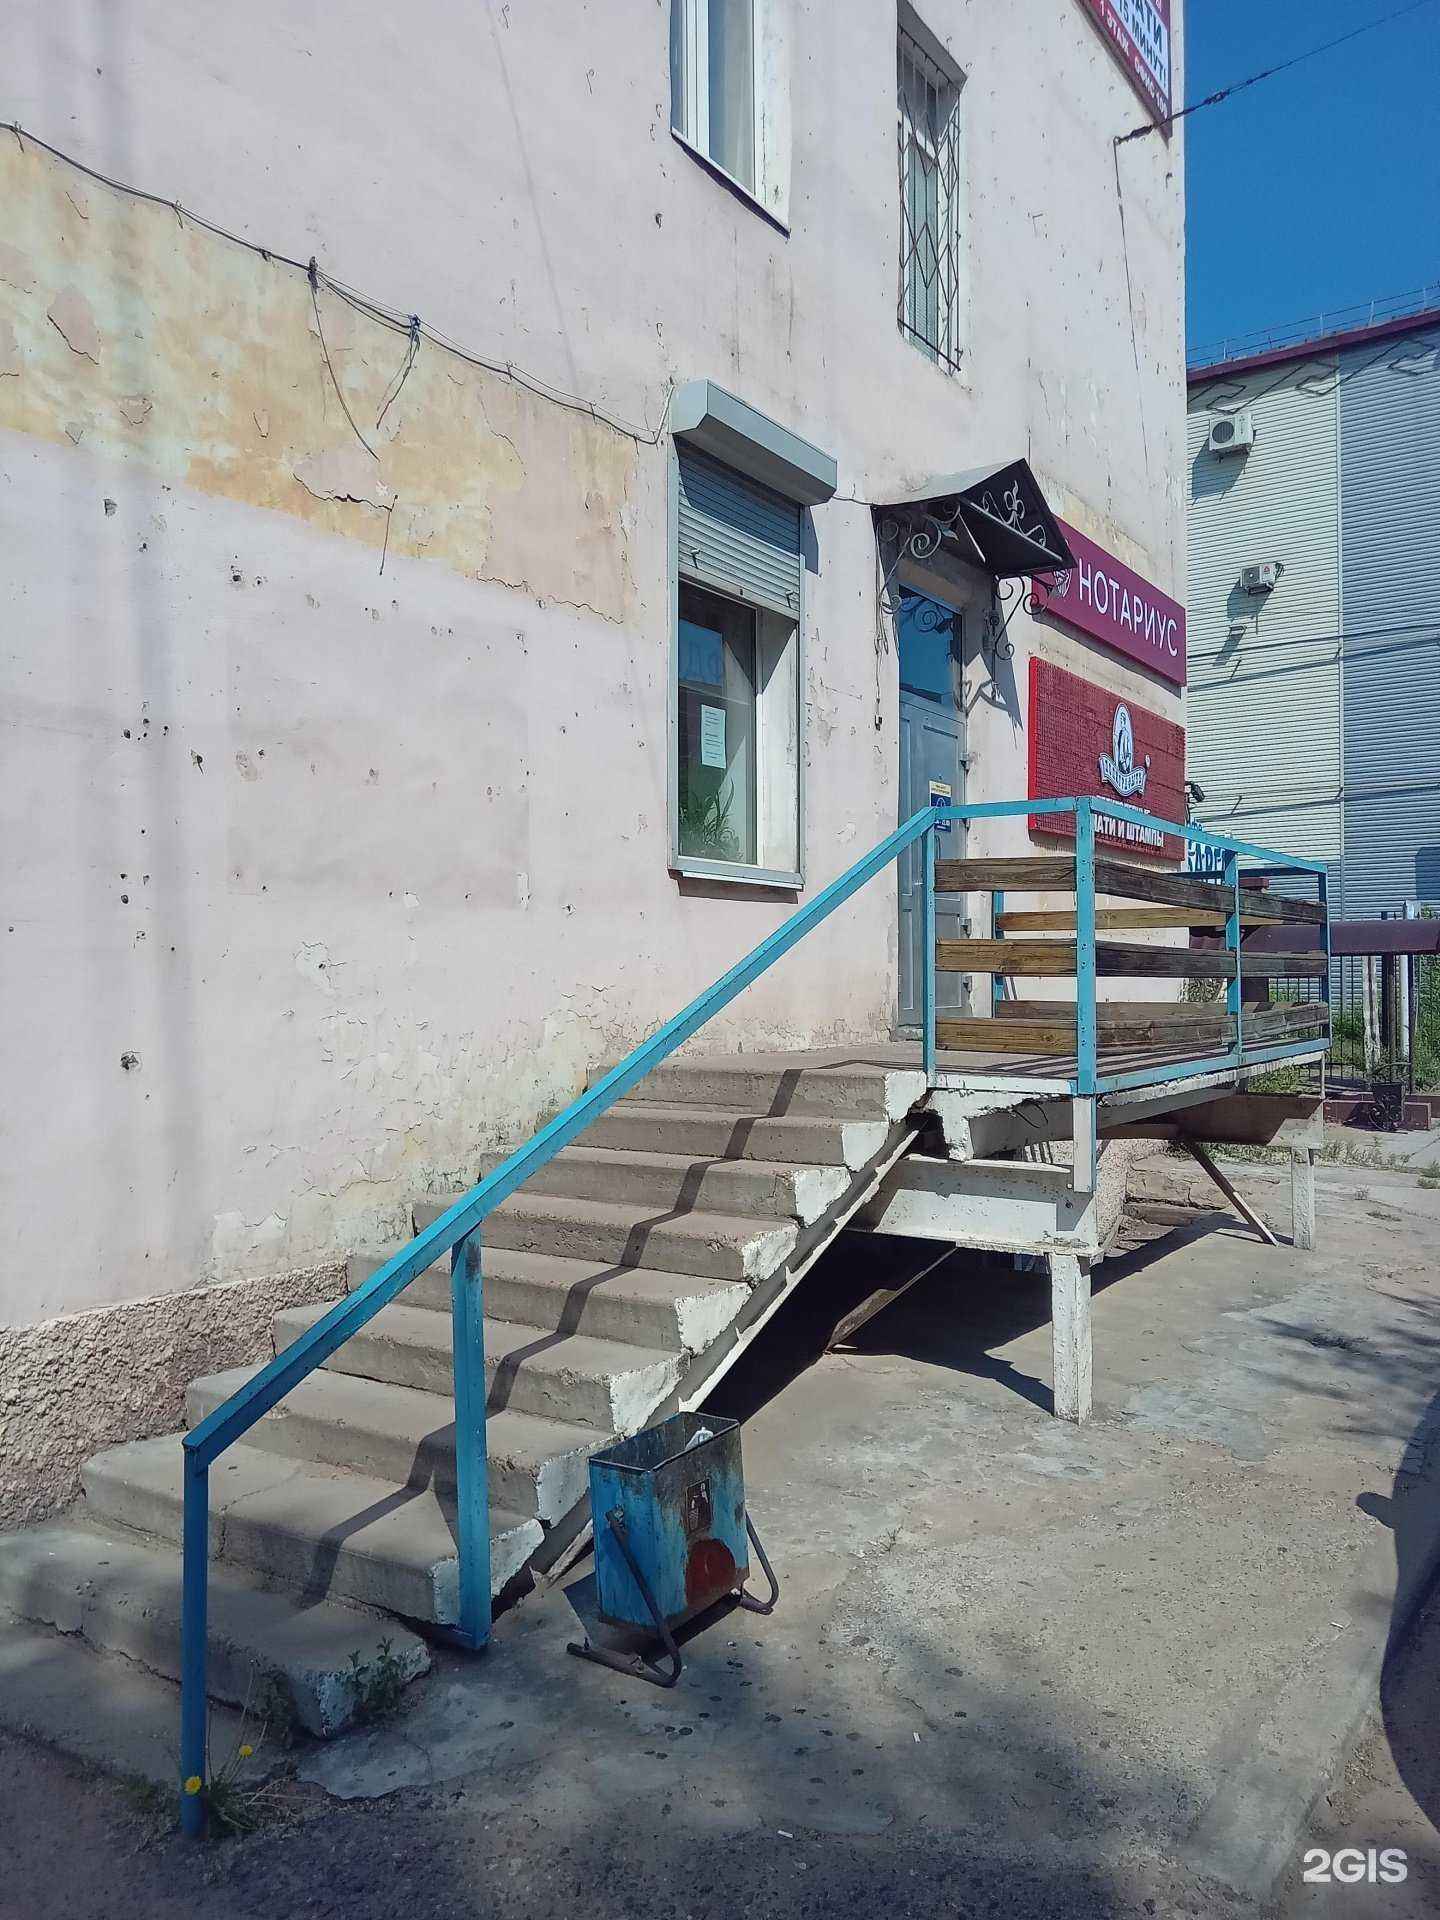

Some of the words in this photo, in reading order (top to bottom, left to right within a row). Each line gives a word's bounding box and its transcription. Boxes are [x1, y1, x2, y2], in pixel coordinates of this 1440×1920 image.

[1079, 558, 1178, 657] НОТАРИУС
[1117, 819, 1125, 839] И
[1126, 821, 1164, 848] ШТАМПЫ
